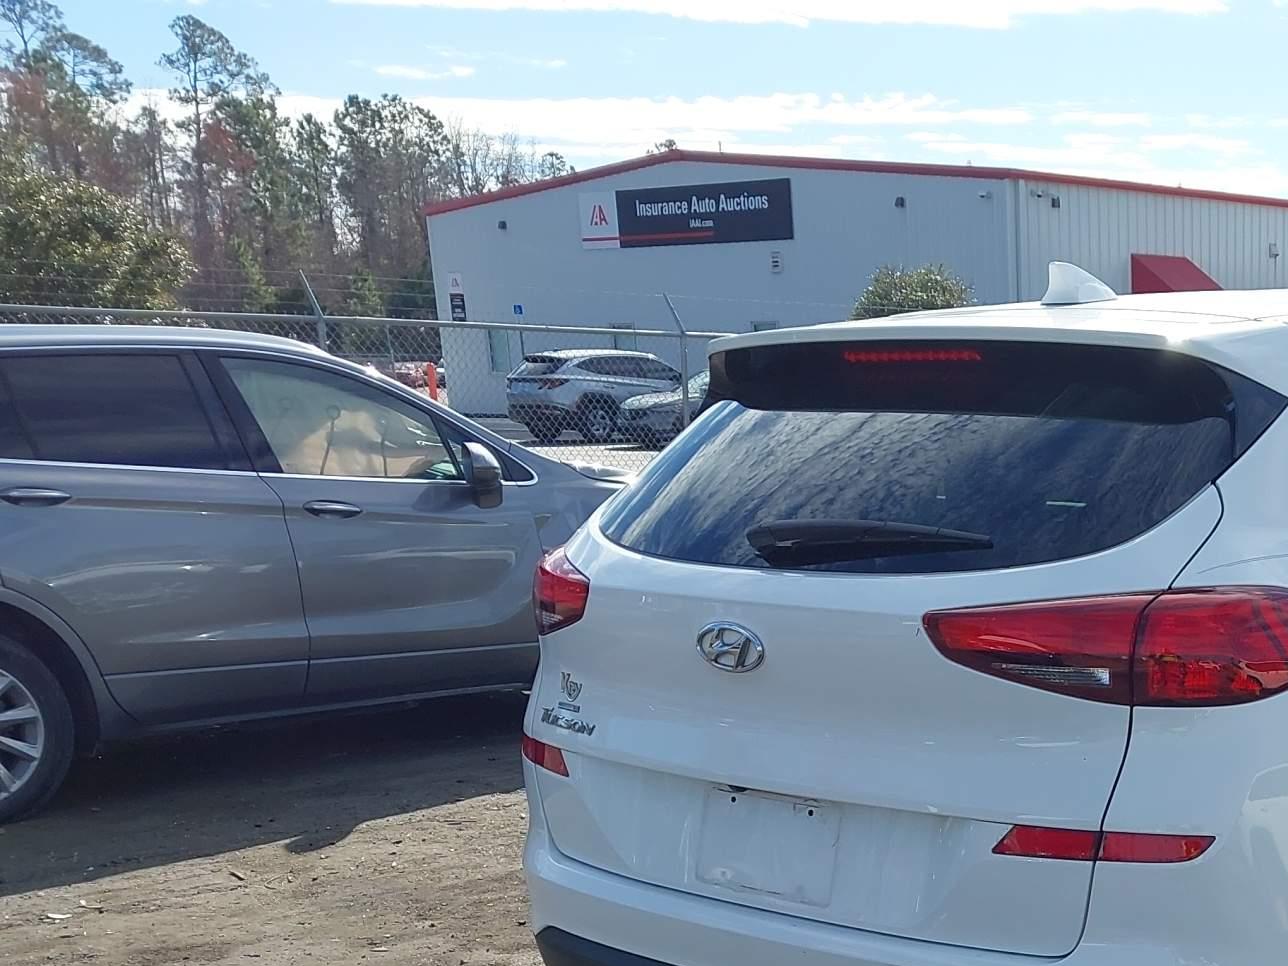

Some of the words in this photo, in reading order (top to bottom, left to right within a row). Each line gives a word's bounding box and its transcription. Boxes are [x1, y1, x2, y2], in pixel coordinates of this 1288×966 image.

[636, 199, 689, 217] Insurance
[690, 195, 716, 214] Auto
[718, 191, 769, 212] Auctions
